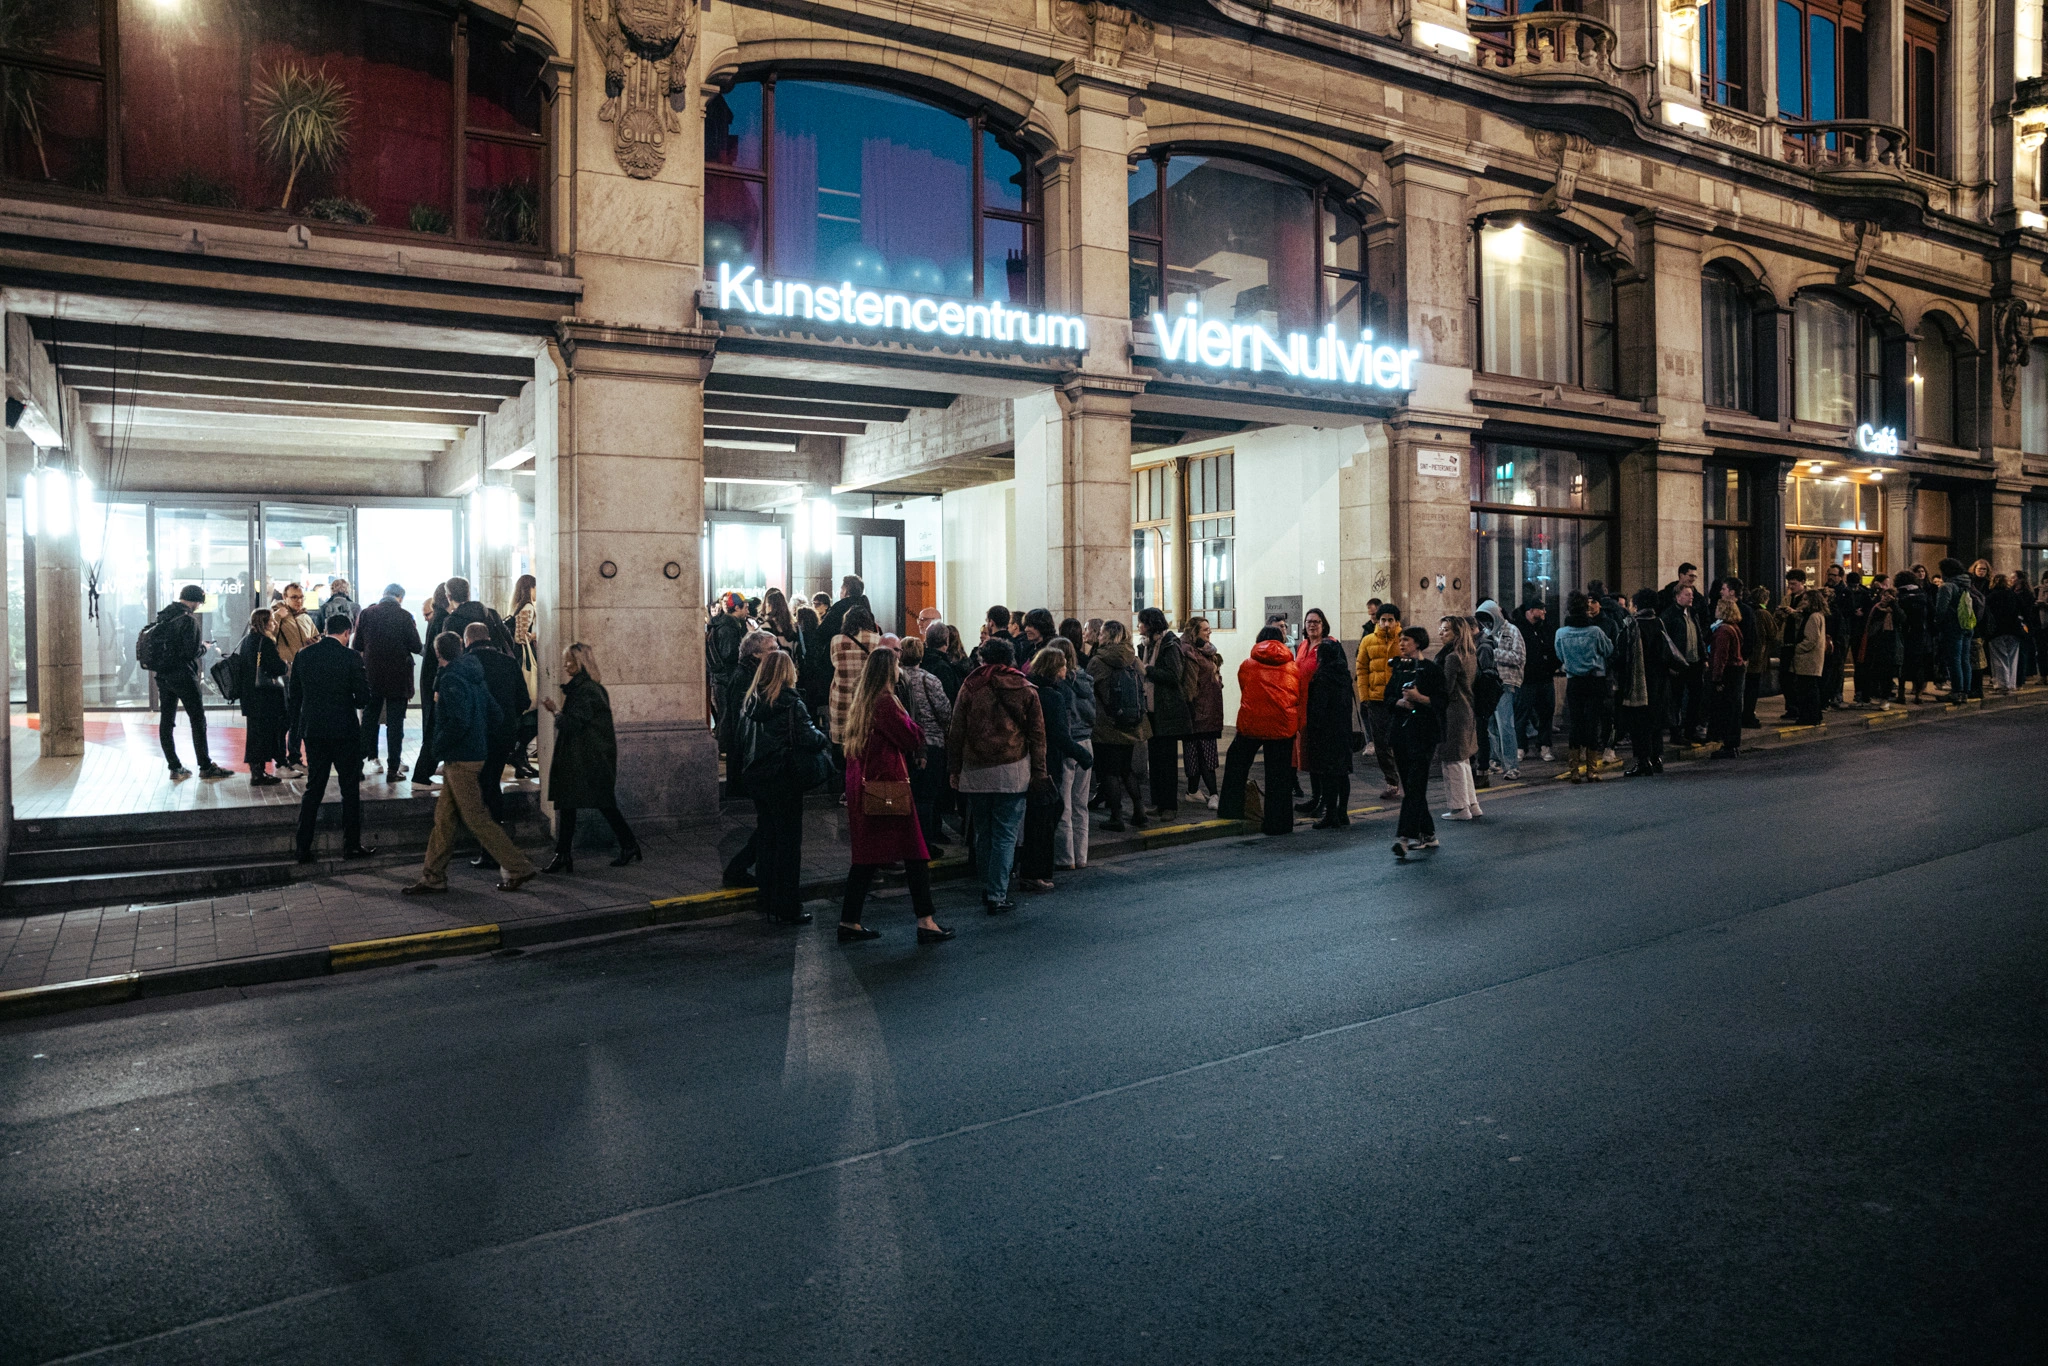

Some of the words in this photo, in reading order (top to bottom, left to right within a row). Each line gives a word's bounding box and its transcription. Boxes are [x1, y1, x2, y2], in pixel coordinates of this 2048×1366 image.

[720, 262, 1086, 350] Kunstencentrum
[1858, 423, 1898, 455] Café
[1436, 481, 1446, 490] 23
